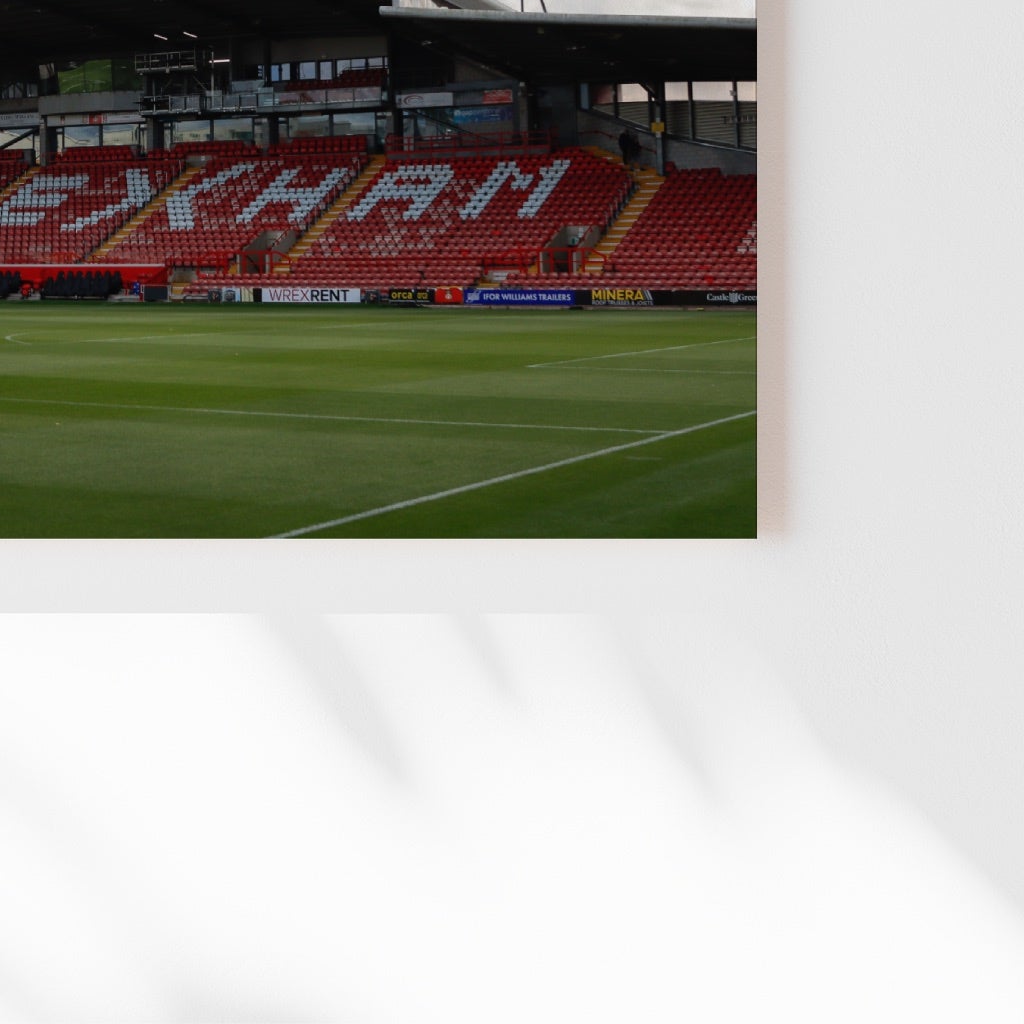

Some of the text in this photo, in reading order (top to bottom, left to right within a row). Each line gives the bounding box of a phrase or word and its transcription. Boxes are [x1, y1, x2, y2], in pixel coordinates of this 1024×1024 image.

[269, 289, 350, 302] WREXRENT
[391, 291, 413, 300] orca
[483, 293, 571, 302] IFOR WILLIAMS TRAILERS
[592, 289, 644, 301] MINERA
[706, 292, 757, 301] Castle Gree
